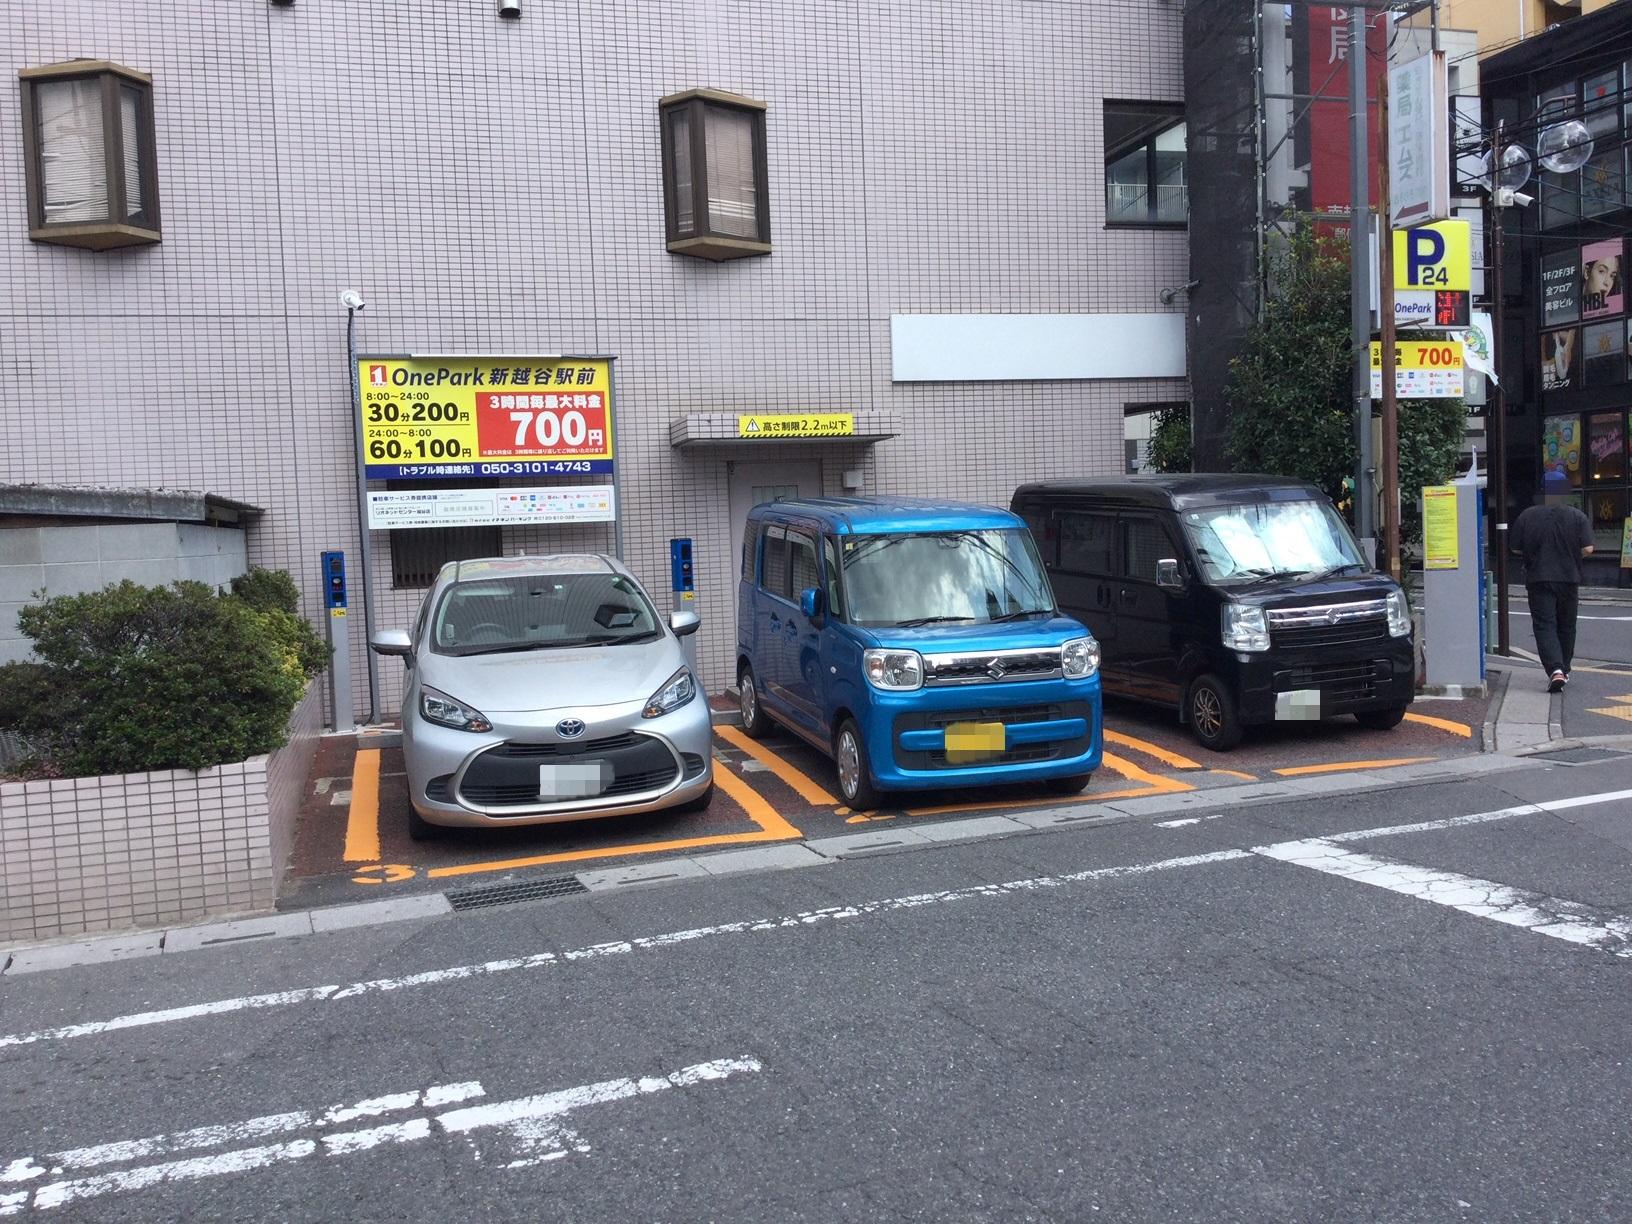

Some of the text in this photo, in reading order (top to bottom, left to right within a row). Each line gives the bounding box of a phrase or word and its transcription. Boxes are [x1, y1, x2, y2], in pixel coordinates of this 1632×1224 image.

[1407, 228, 1445, 286] P
[1421, 266, 1448, 286] 24
[1542, 266, 1576, 281] 1F/2F/3F
[1545, 282, 1573, 296] 全フロア
[1395, 302, 1432, 313] OnePark
[1417, 347, 1460, 366] 700円
[392, 366, 596, 386] OnePark 新越谷駅前
[489, 394, 602, 409] 3時間毎最大料金
[367, 402, 470, 422] 30分200円
[510, 410, 603, 447] 700円
[762, 419, 847, 432] 高さ制限2.2m以下
[370, 438, 472, 459] 60分100円
[481, 461, 591, 475] 050-3101-4743
